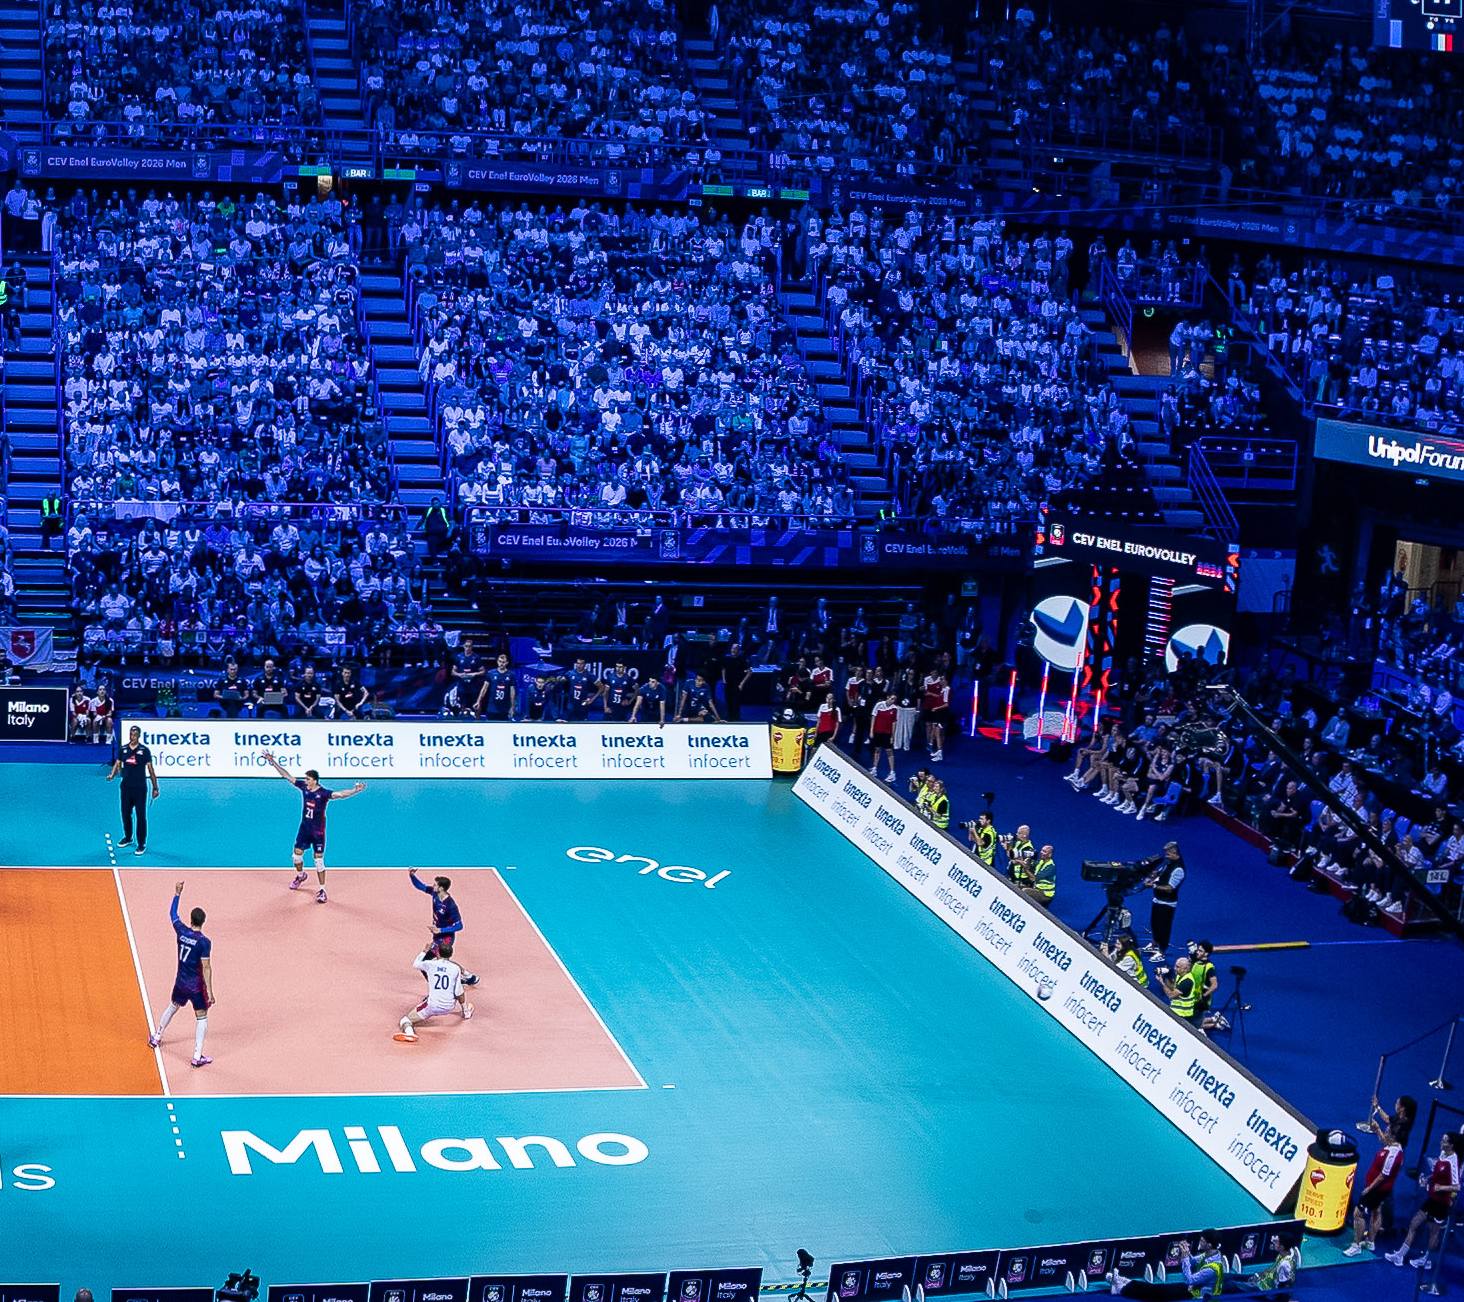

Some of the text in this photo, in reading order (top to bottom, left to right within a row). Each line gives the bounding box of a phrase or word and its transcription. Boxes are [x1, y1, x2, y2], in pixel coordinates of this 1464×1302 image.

[47, 157, 186, 169] CEV Enel EuroVolley 2026 Men
[350, 169, 367, 177] BAR
[468, 170, 598, 185] CEV Enel EuroVolley 2026 Men
[498, 535, 519, 545] CEV
[521, 536, 544, 546] Enel
[603, 537, 627, 547] 2026
[1072, 534, 1196, 565] CEV ENEL EUROVOLLEY
[8, 701, 50, 713] Milano
[7, 714, 35, 728] Italy
[328, 733, 749, 748] tinexta tinexta
[328, 752, 751, 768] infocert infocert
[305, 808, 314, 819] 21
[566, 847, 731, 888] enel
[179, 945, 191, 962] 17
[433, 974, 449, 990] 20
[873, 805, 1298, 1163] tinexta tinexta tinexta
[862, 823, 1281, 1189] infocert infocert infocert
[221, 1126, 649, 1174] Milano
[1300, 1202, 1325, 1219] 110.1
